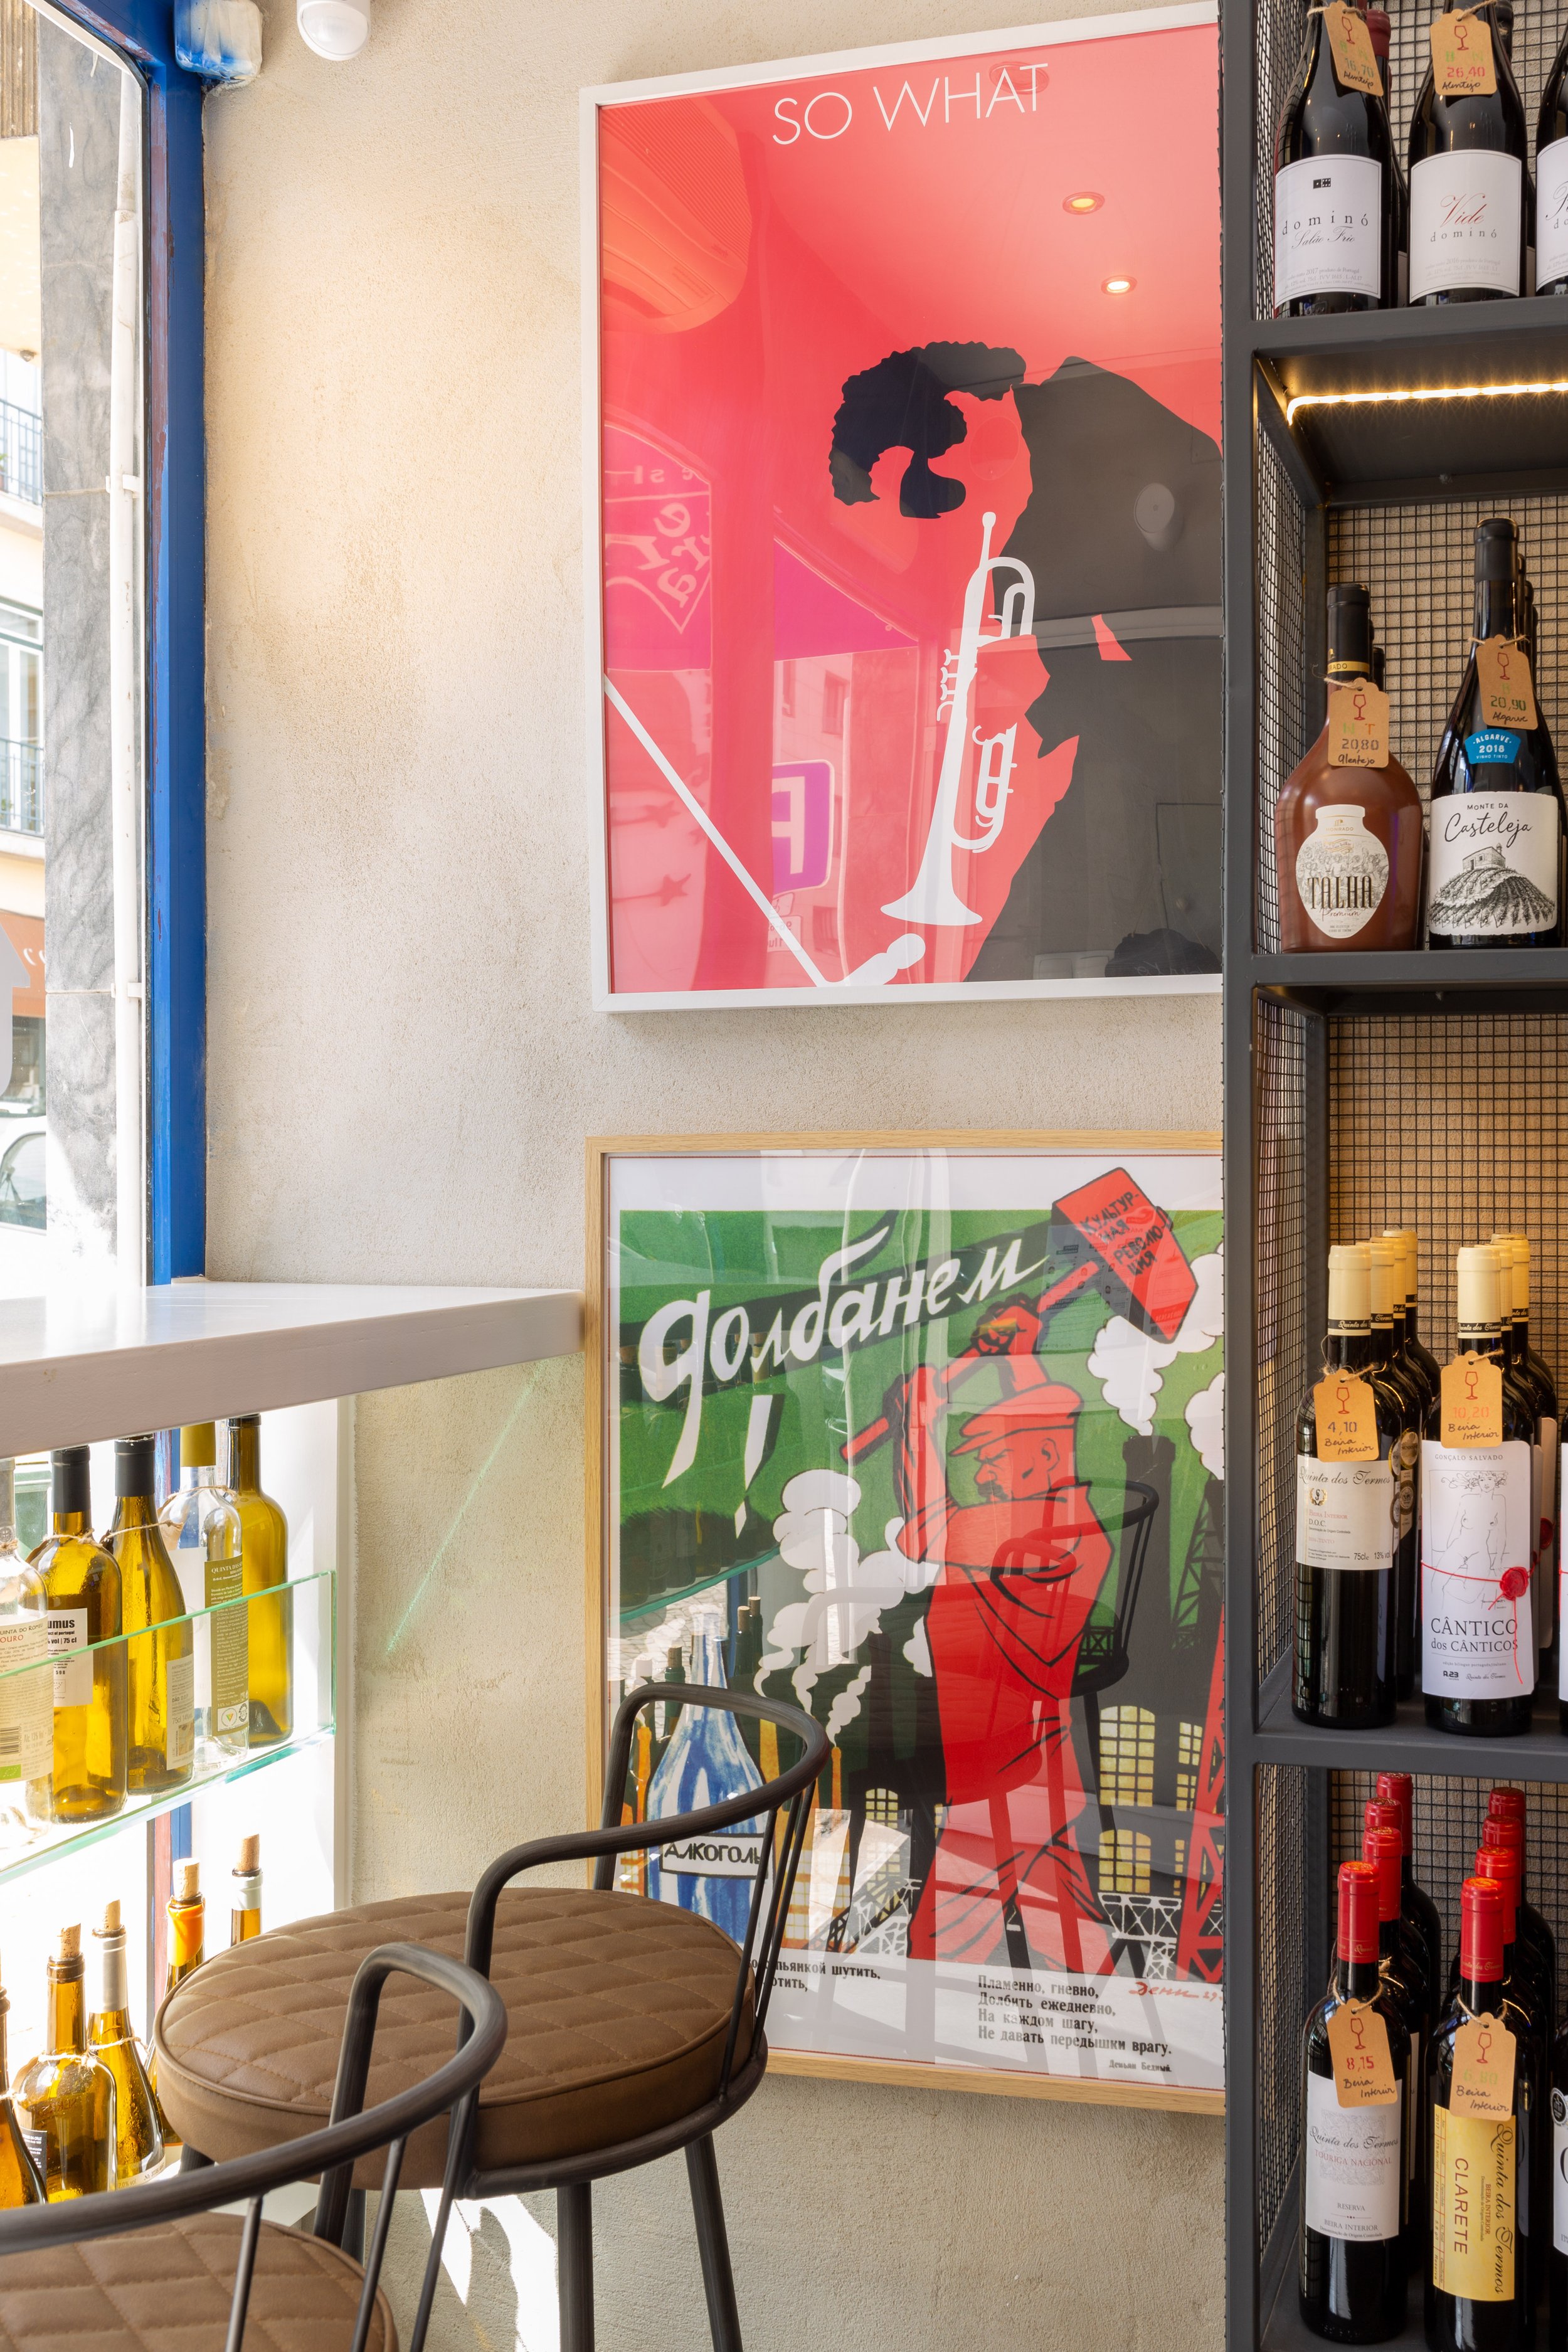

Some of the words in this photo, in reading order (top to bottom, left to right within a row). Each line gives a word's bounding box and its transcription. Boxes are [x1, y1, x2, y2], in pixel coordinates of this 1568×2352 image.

[1446, 66, 1485, 80] 26,40
[1442, 81, 1481, 93] Alentejo
[772, 92, 852, 145] SO
[872, 63, 1049, 132] WHAT
[1440, 193, 1487, 228] Vide
[1281, 210, 1369, 235] dominó
[1327, 225, 1355, 242] Frio
[1430, 227, 1497, 242] dominó
[1306, 267, 1318, 275] 2017
[1490, 695, 1527, 711] 20,90
[1493, 711, 1528, 725] Algarve
[1342, 738, 1379, 753] 20,80
[1479, 744, 1505, 753] 2018
[1444, 811, 1534, 849] Casteleja
[1307, 875, 1374, 909] TALHA
[1320, 908, 1361, 922] Premium
[1453, 1406, 1489, 1421] 10,20
[1328, 1421, 1357, 1436] 4,10
[1325, 1438, 1356, 1447] Beira
[1298, 1466, 1329, 1485] Quinta
[1332, 1471, 1348, 1485] dos
[1353, 1470, 1391, 1485] Termos
[1309, 1518, 1327, 1527] D.O.C.
[211, 1565, 231, 1574] QUINTA
[1431, 1616, 1518, 1636] CÂNTICO
[1431, 1638, 1448, 1650] dos
[1451, 1639, 1518, 1653] CÂNTICOS
[664, 1841, 761, 1865] АЛКОГОЛЬ
[978, 1975, 1046, 1995] Пламенно,
[1051, 1983, 1099, 2000] гневно,
[978, 1991, 1033, 2008] Долбить
[1041, 1998, 1116, 2017] ежедневно,
[978, 2008, 995, 2023] На
[1003, 2011, 1054, 2028] каждом
[1062, 2018, 1098, 2034] шагу,
[978, 2025, 995, 2040] Не
[1000, 2028, 1044, 2044] давать
[1051, 2035, 1126, 2052] передышки
[1131, 2040, 1172, 2057] врагу.
[1346, 2055, 1375, 2072] 8,15
[1343, 2077, 1374, 2089] Beira
[1456, 2085, 1491, 2097] Beira
[1309, 2126, 1340, 2146] Quinta
[1343, 2137, 1359, 2149] dos
[1363, 2136, 1399, 2149] Termos
[1315, 2149, 1348, 2166] TOURIGA
[1350, 2157, 1392, 2167] NACIONAL
[1490, 2124, 1513, 2189] Quinta
[1337, 2202, 1366, 2212] RESERVA
[1454, 2158, 1468, 2254] CLARETE
[1495, 2193, 1510, 2220] dos
[1324, 2218, 1343, 2230] BEIRA
[1494, 2227, 1513, 2294] Termos
